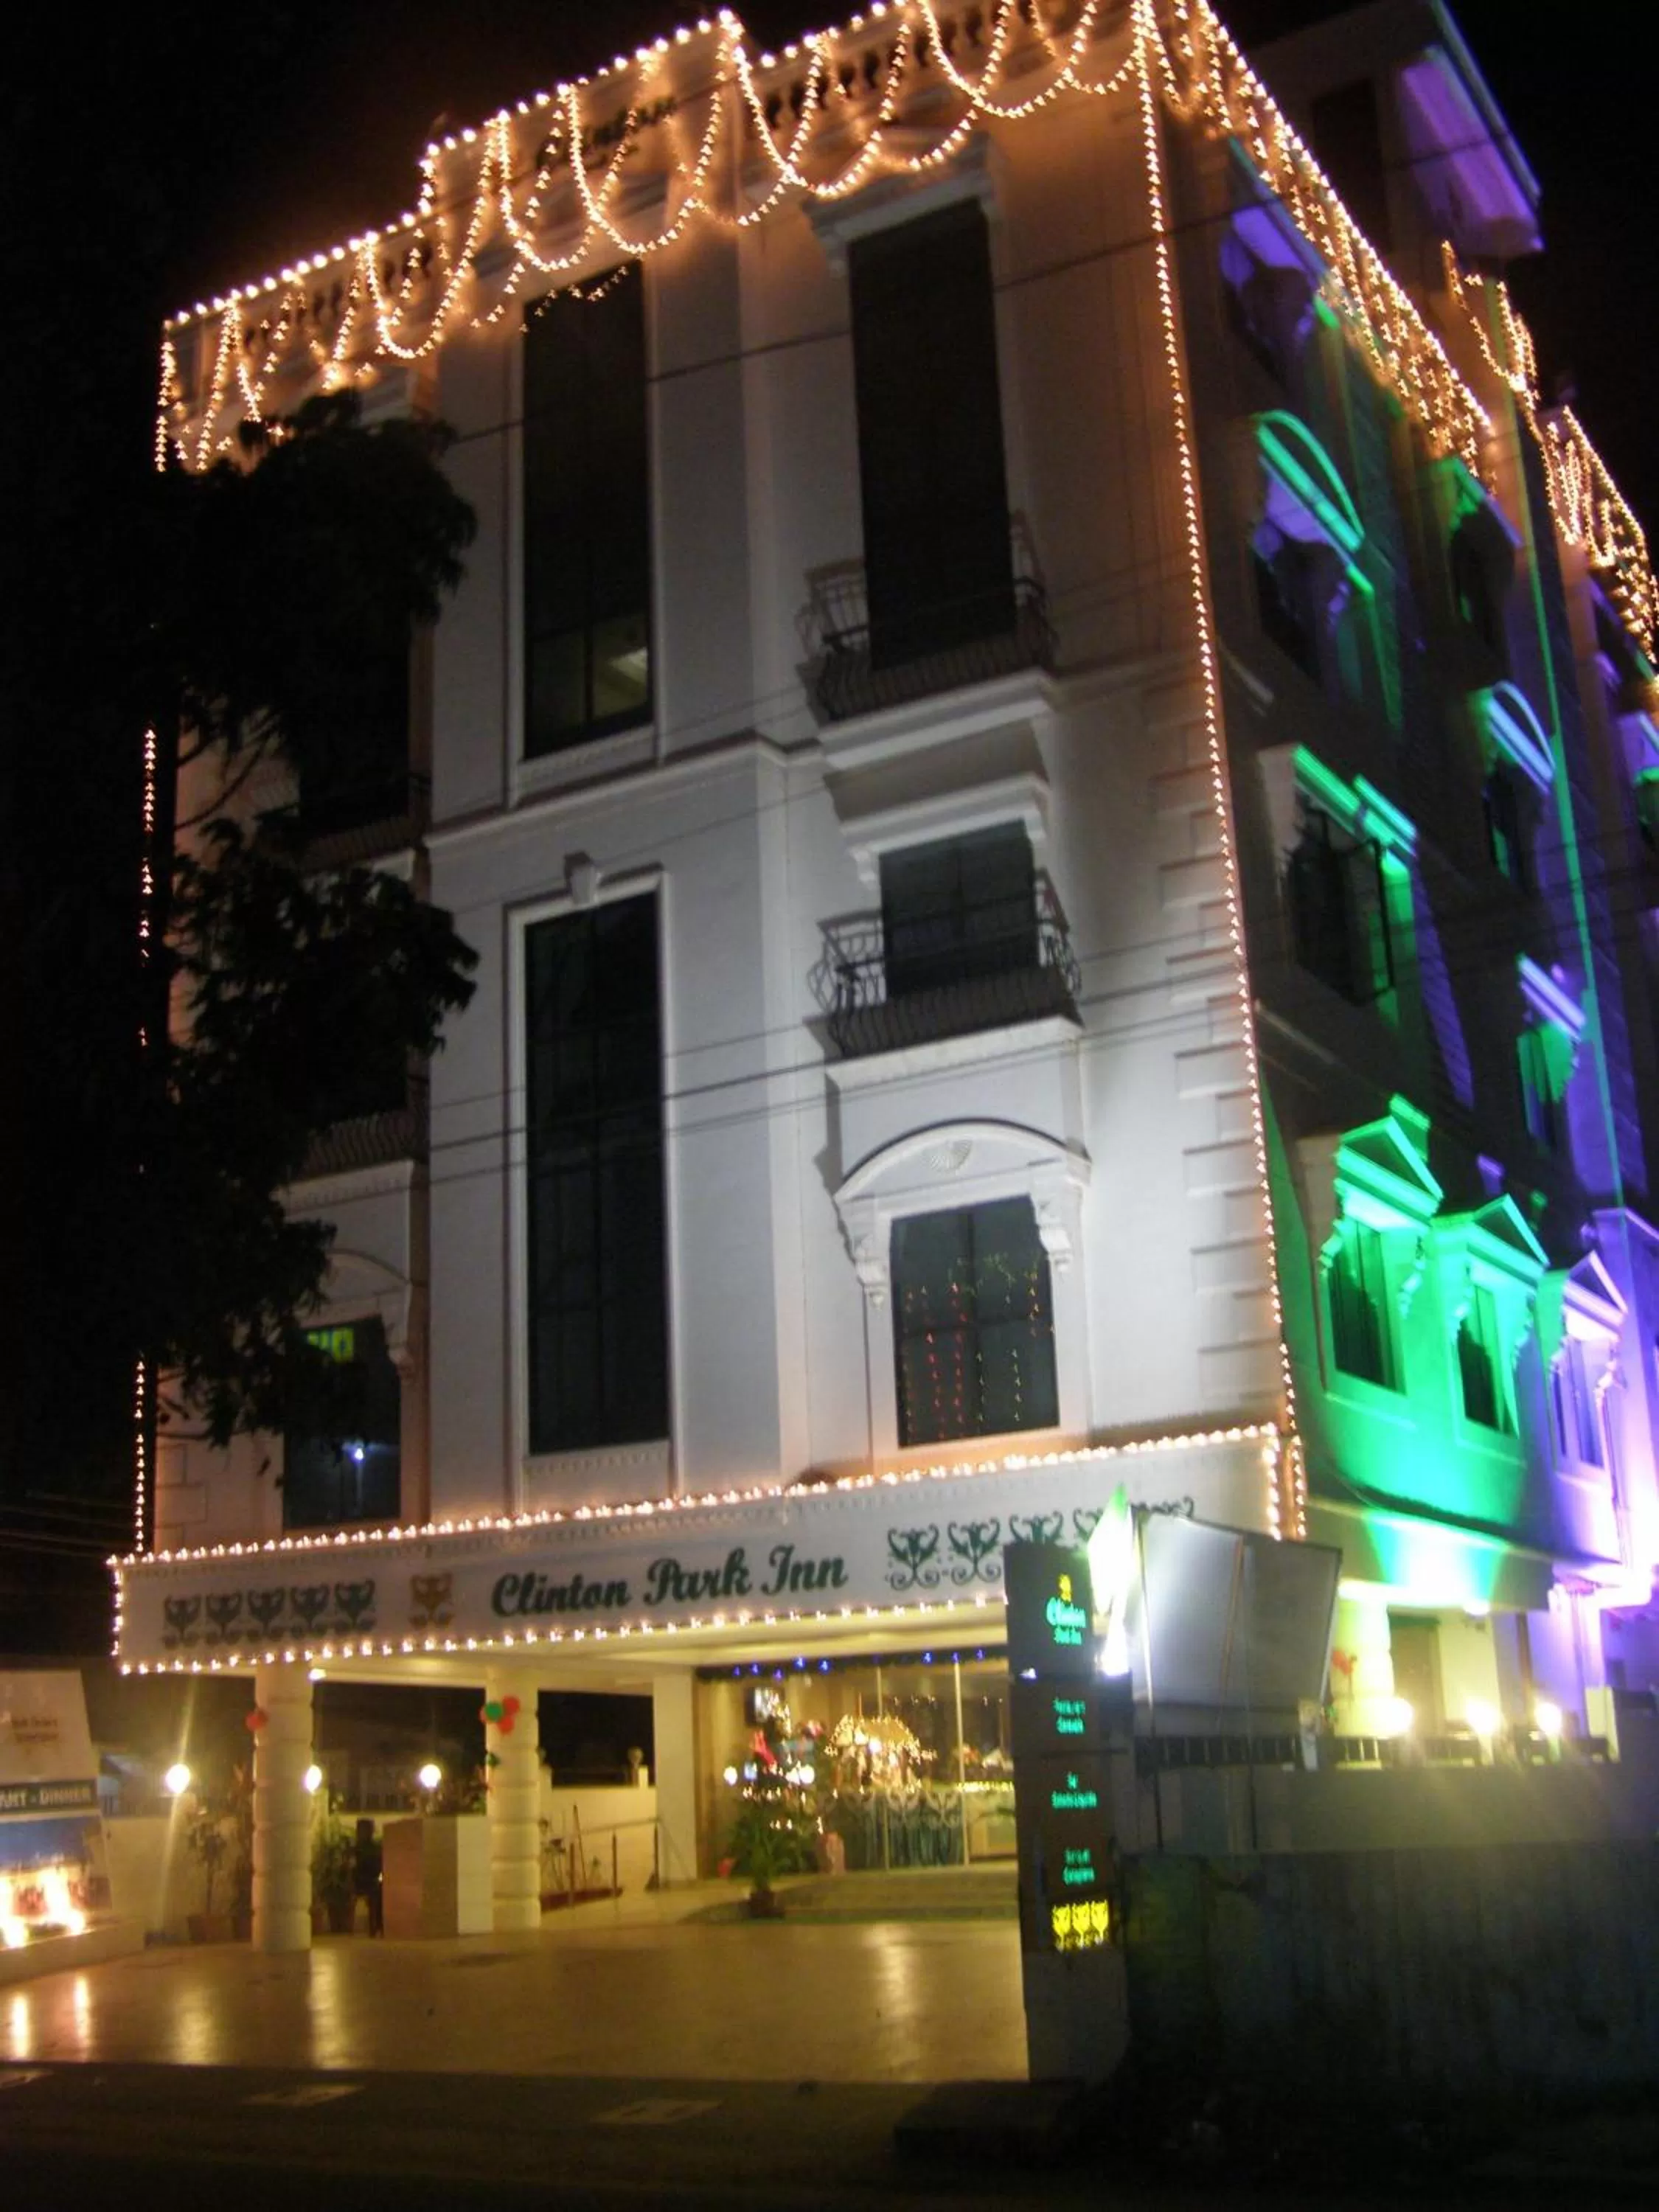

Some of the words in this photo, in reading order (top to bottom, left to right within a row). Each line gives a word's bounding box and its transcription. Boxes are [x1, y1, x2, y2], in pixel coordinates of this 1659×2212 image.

[491, 1572, 632, 1617] Clinton
[643, 1547, 752, 1607] Park
[760, 1544, 849, 1596] Inn
